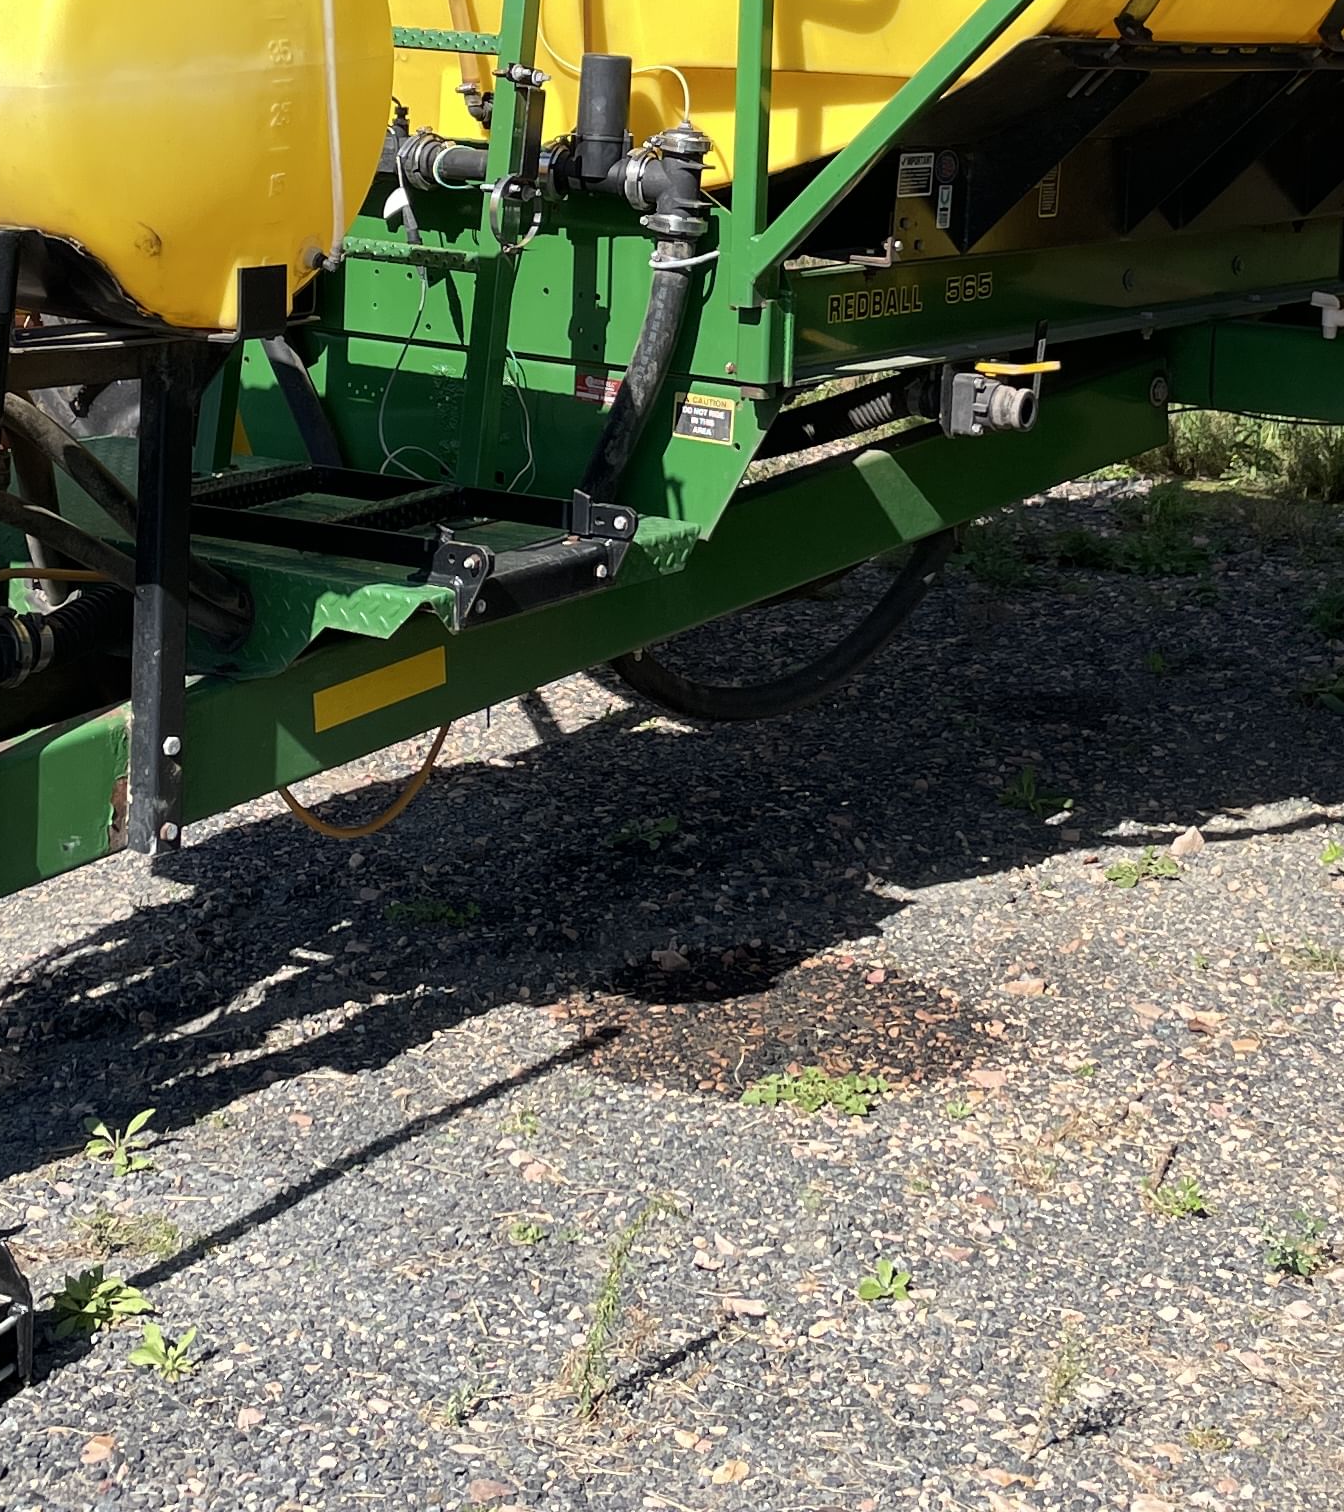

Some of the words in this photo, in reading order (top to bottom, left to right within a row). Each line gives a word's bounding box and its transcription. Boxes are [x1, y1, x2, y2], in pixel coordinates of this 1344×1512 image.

[267, 38, 293, 64] 35
[827, 285, 923, 324] REDBALL
[945, 272, 993, 304] 565
[682, 406, 692, 414] DO
[693, 408, 708, 416] NOT
[692, 396, 727, 408] CAUTION
